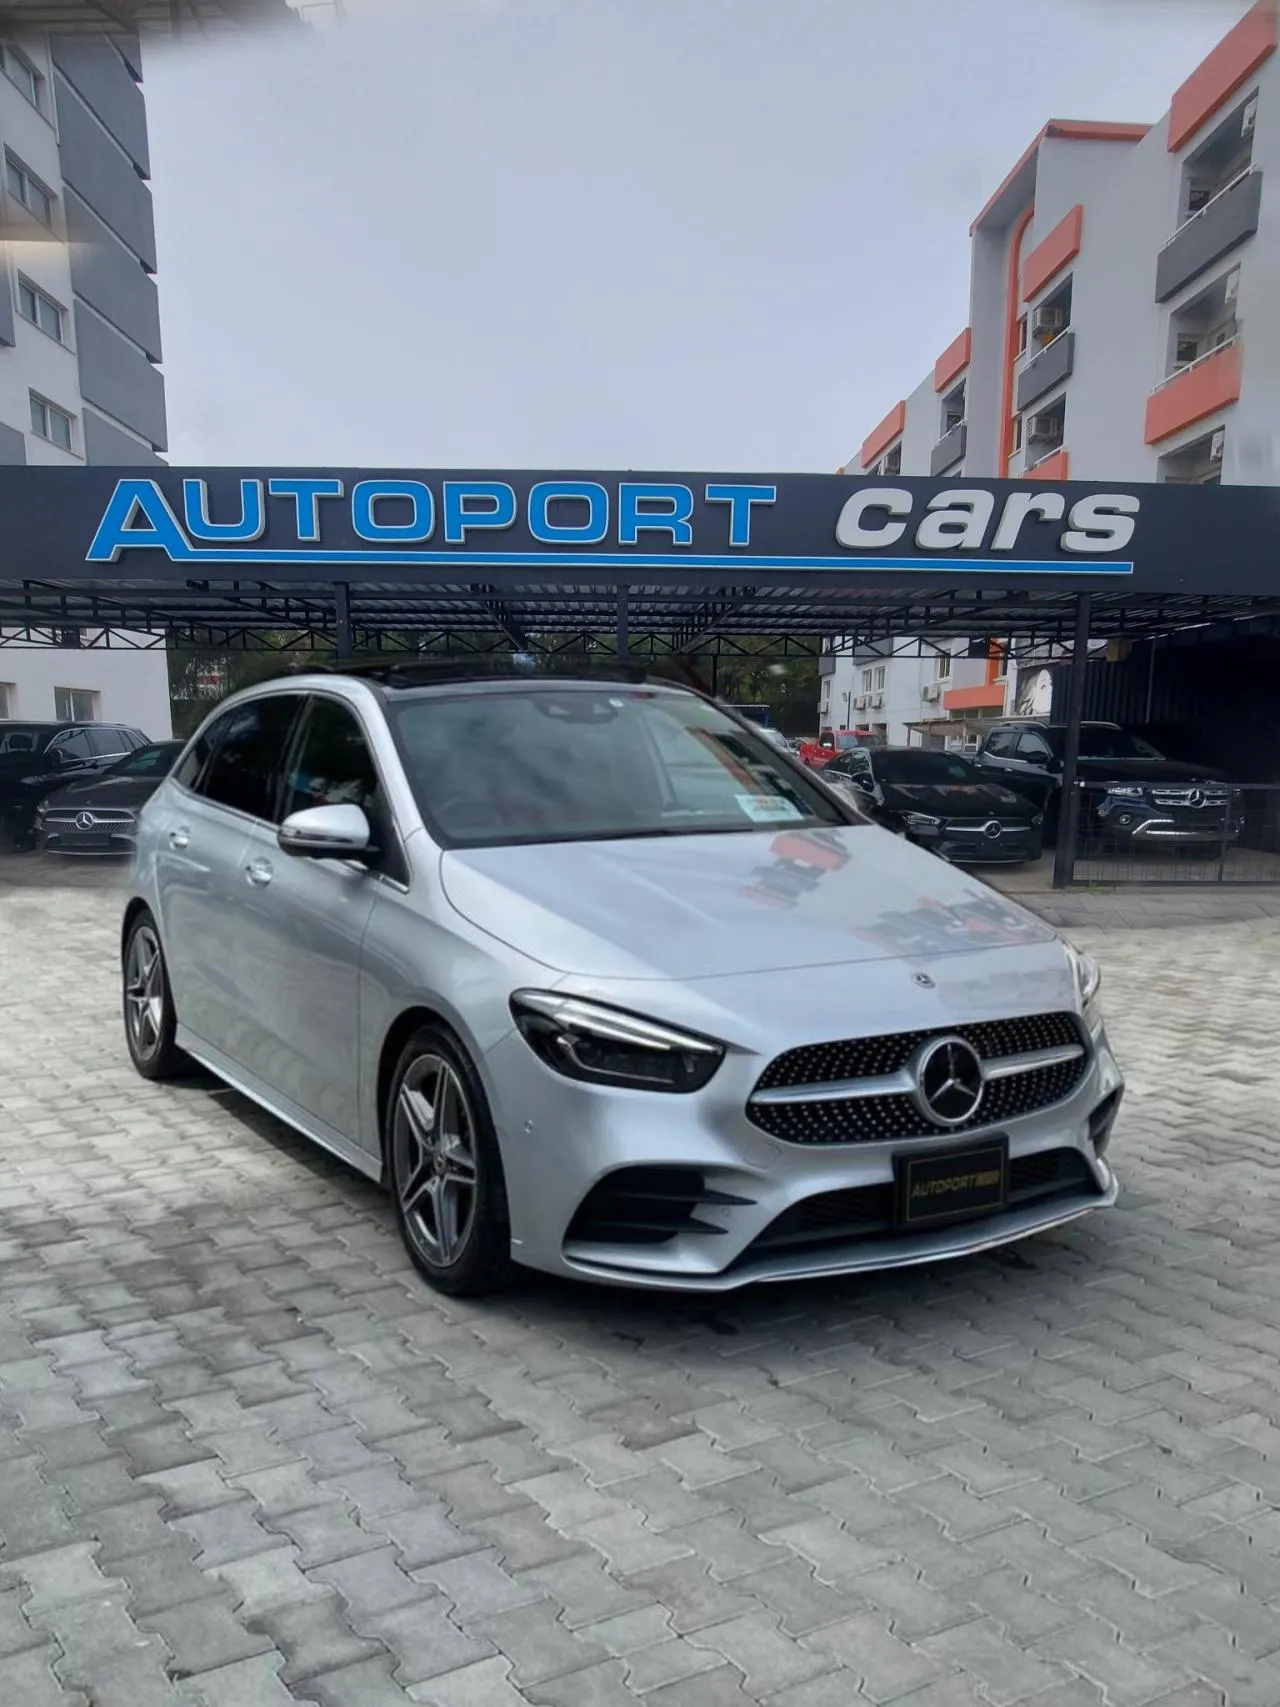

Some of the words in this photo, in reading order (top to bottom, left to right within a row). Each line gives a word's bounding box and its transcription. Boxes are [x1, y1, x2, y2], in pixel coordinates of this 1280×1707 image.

[85, 478, 778, 562] AUTOPORT
[835, 487, 1141, 553] cars
[911, 1174, 976, 1199] AUTOPORT
